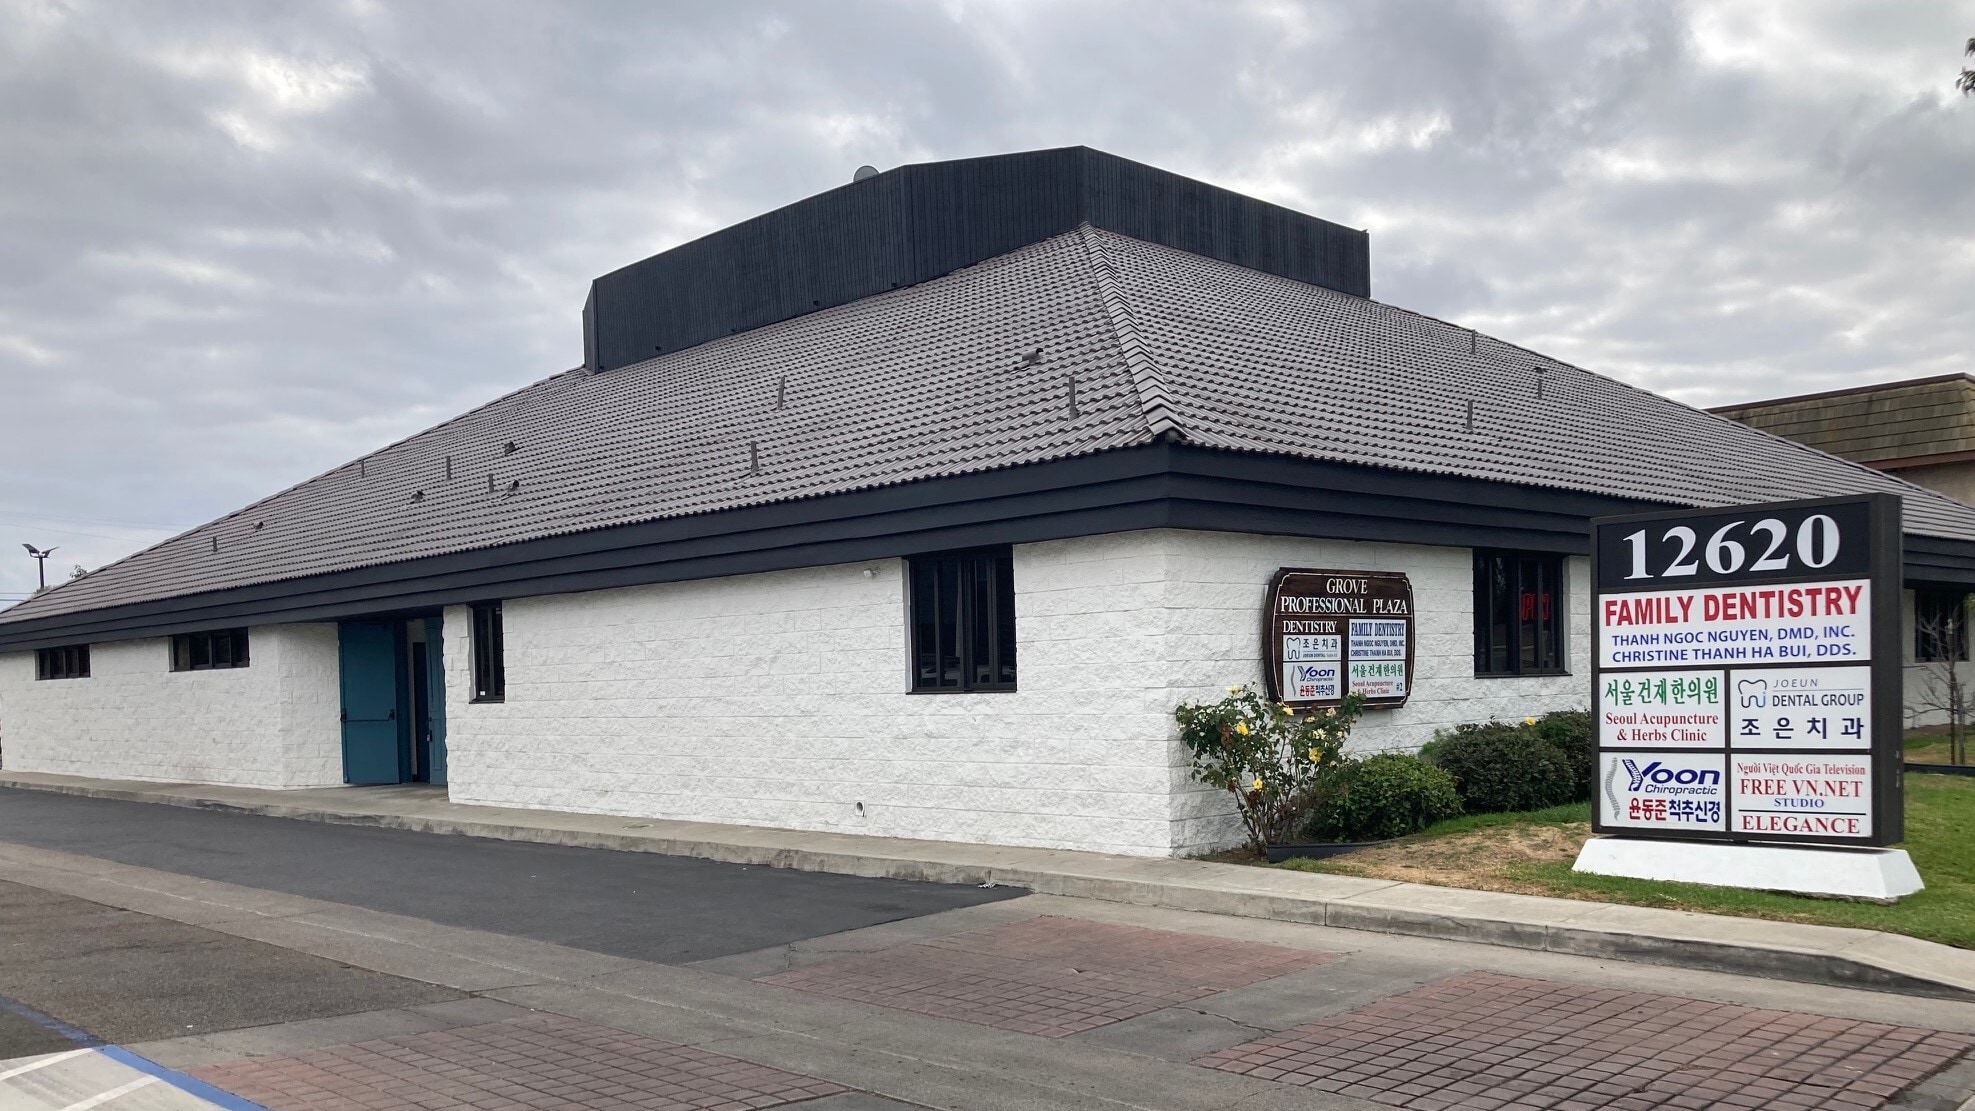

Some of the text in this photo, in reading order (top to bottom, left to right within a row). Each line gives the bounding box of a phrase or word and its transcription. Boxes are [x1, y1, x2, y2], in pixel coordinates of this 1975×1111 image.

[1623, 514, 1840, 580] 12620
[1326, 578, 1368, 595] GROVE
[1281, 596, 1408, 614] PROFESSIONAL PLAZA
[1605, 585, 1862, 626] FAMILY DENTISTRY
[1283, 620, 1337, 633] DENTISTRY
[1351, 622, 1405, 637] FAMILY DENTISTRY
[1612, 625, 1855, 646] THANH NGOC NGUYEN, DMD, INC.
[1612, 643, 1856, 663] CHRISTINE THANH HA BUI, DDS.
[1297, 666, 1335, 681] Yoon
[1773, 679, 1818, 688] JOEUN
[1772, 693, 1864, 707] DENTAL GROUP
[1606, 712, 1719, 728] Seoul Acupuncture
[1617, 728, 1707, 742] & Herbs Clinic
[1622, 759, 1721, 791] Yoon
[1805, 763, 1821, 775] Gia
[1824, 763, 1866, 775] Television
[1645, 784, 1718, 796] Chiropractic
[1740, 778, 1863, 797] FREE VN.NET
[1774, 797, 1825, 808] STUDIO
[1742, 815, 1860, 834] ELEGANCE
